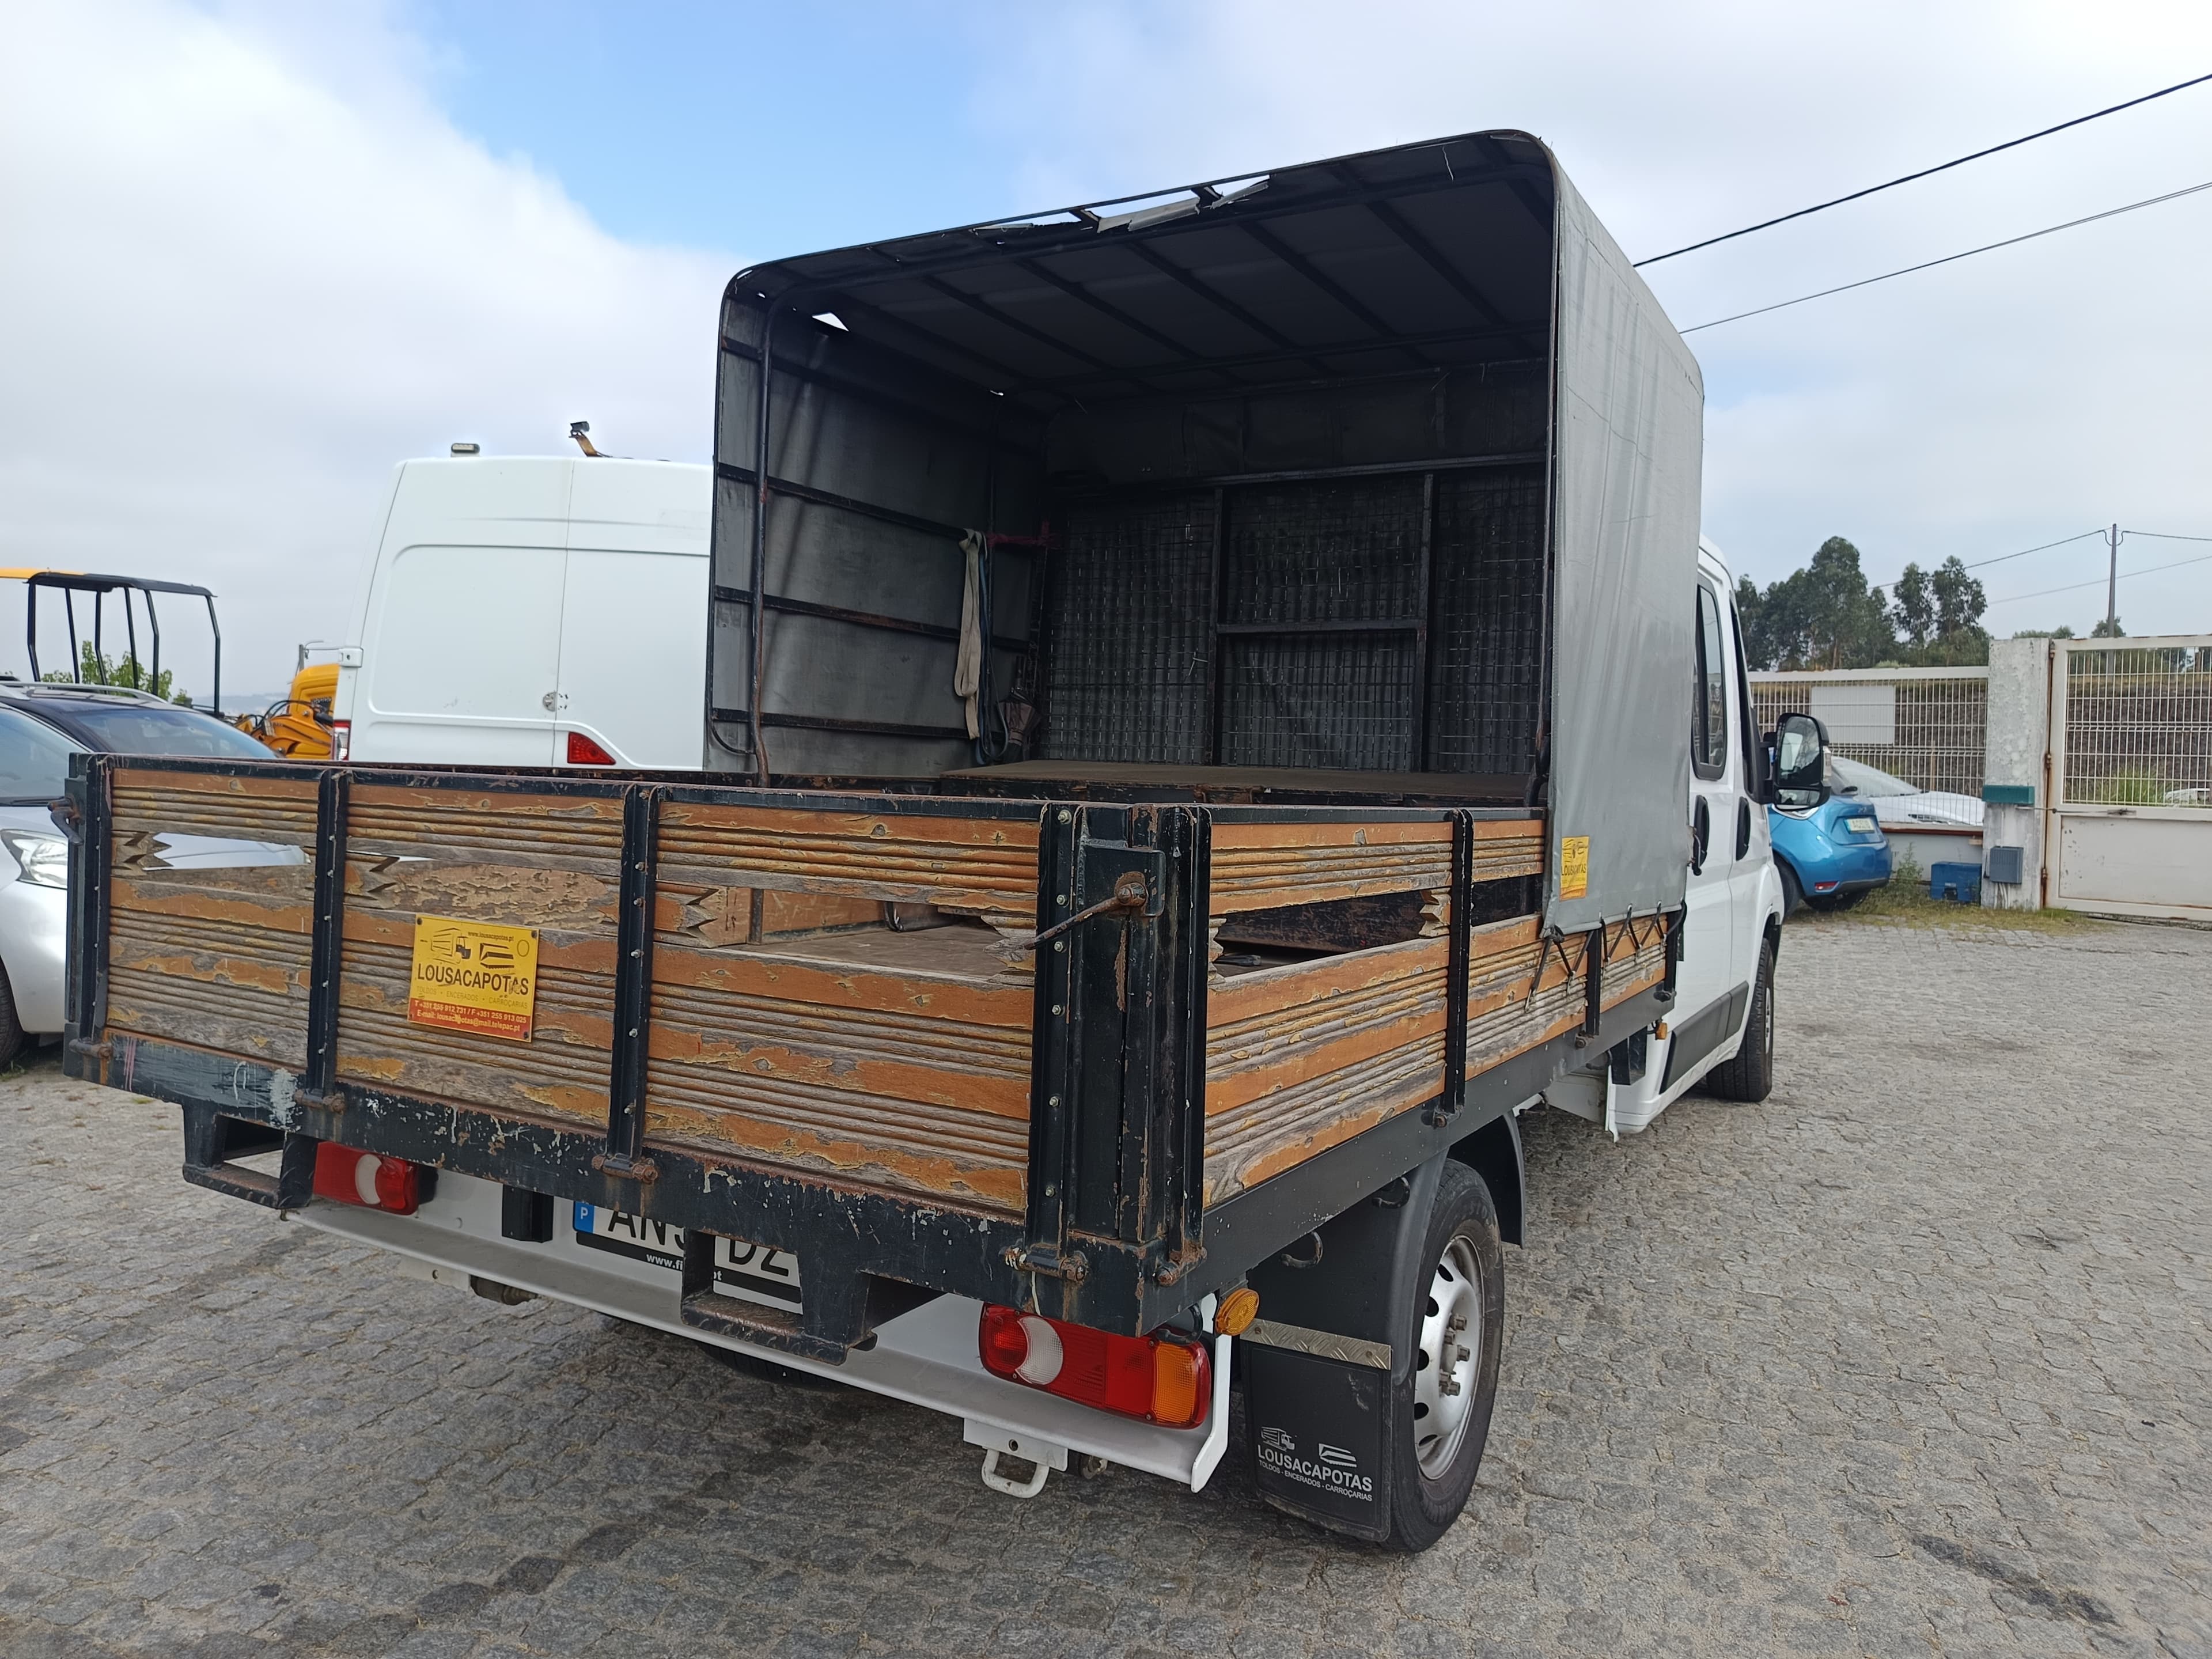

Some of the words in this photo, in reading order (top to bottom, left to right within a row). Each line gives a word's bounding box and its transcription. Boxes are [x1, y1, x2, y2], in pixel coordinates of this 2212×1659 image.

[418, 963, 529, 995] LOUSACAPOTAS
[416, 986, 437, 995] TOLDOS
[446, 990, 479, 1002] ENCERADOS
[488, 997, 528, 1009] CARROÇARIAS
[445, 1005, 456, 1013] 912
[456, 1006, 466, 1014] 731
[491, 1012, 502, 1020] 255
[503, 1014, 515, 1022] 913
[580, 1207, 588, 1219] P
[1257, 1444, 1373, 1492] LOUSACAPOTAS
[1259, 1460, 1281, 1474] TOLDOS
[1285, 1470, 1321, 1488] ENCERADOS
[1325, 1484, 1373, 1502] CARROÇARIAS
